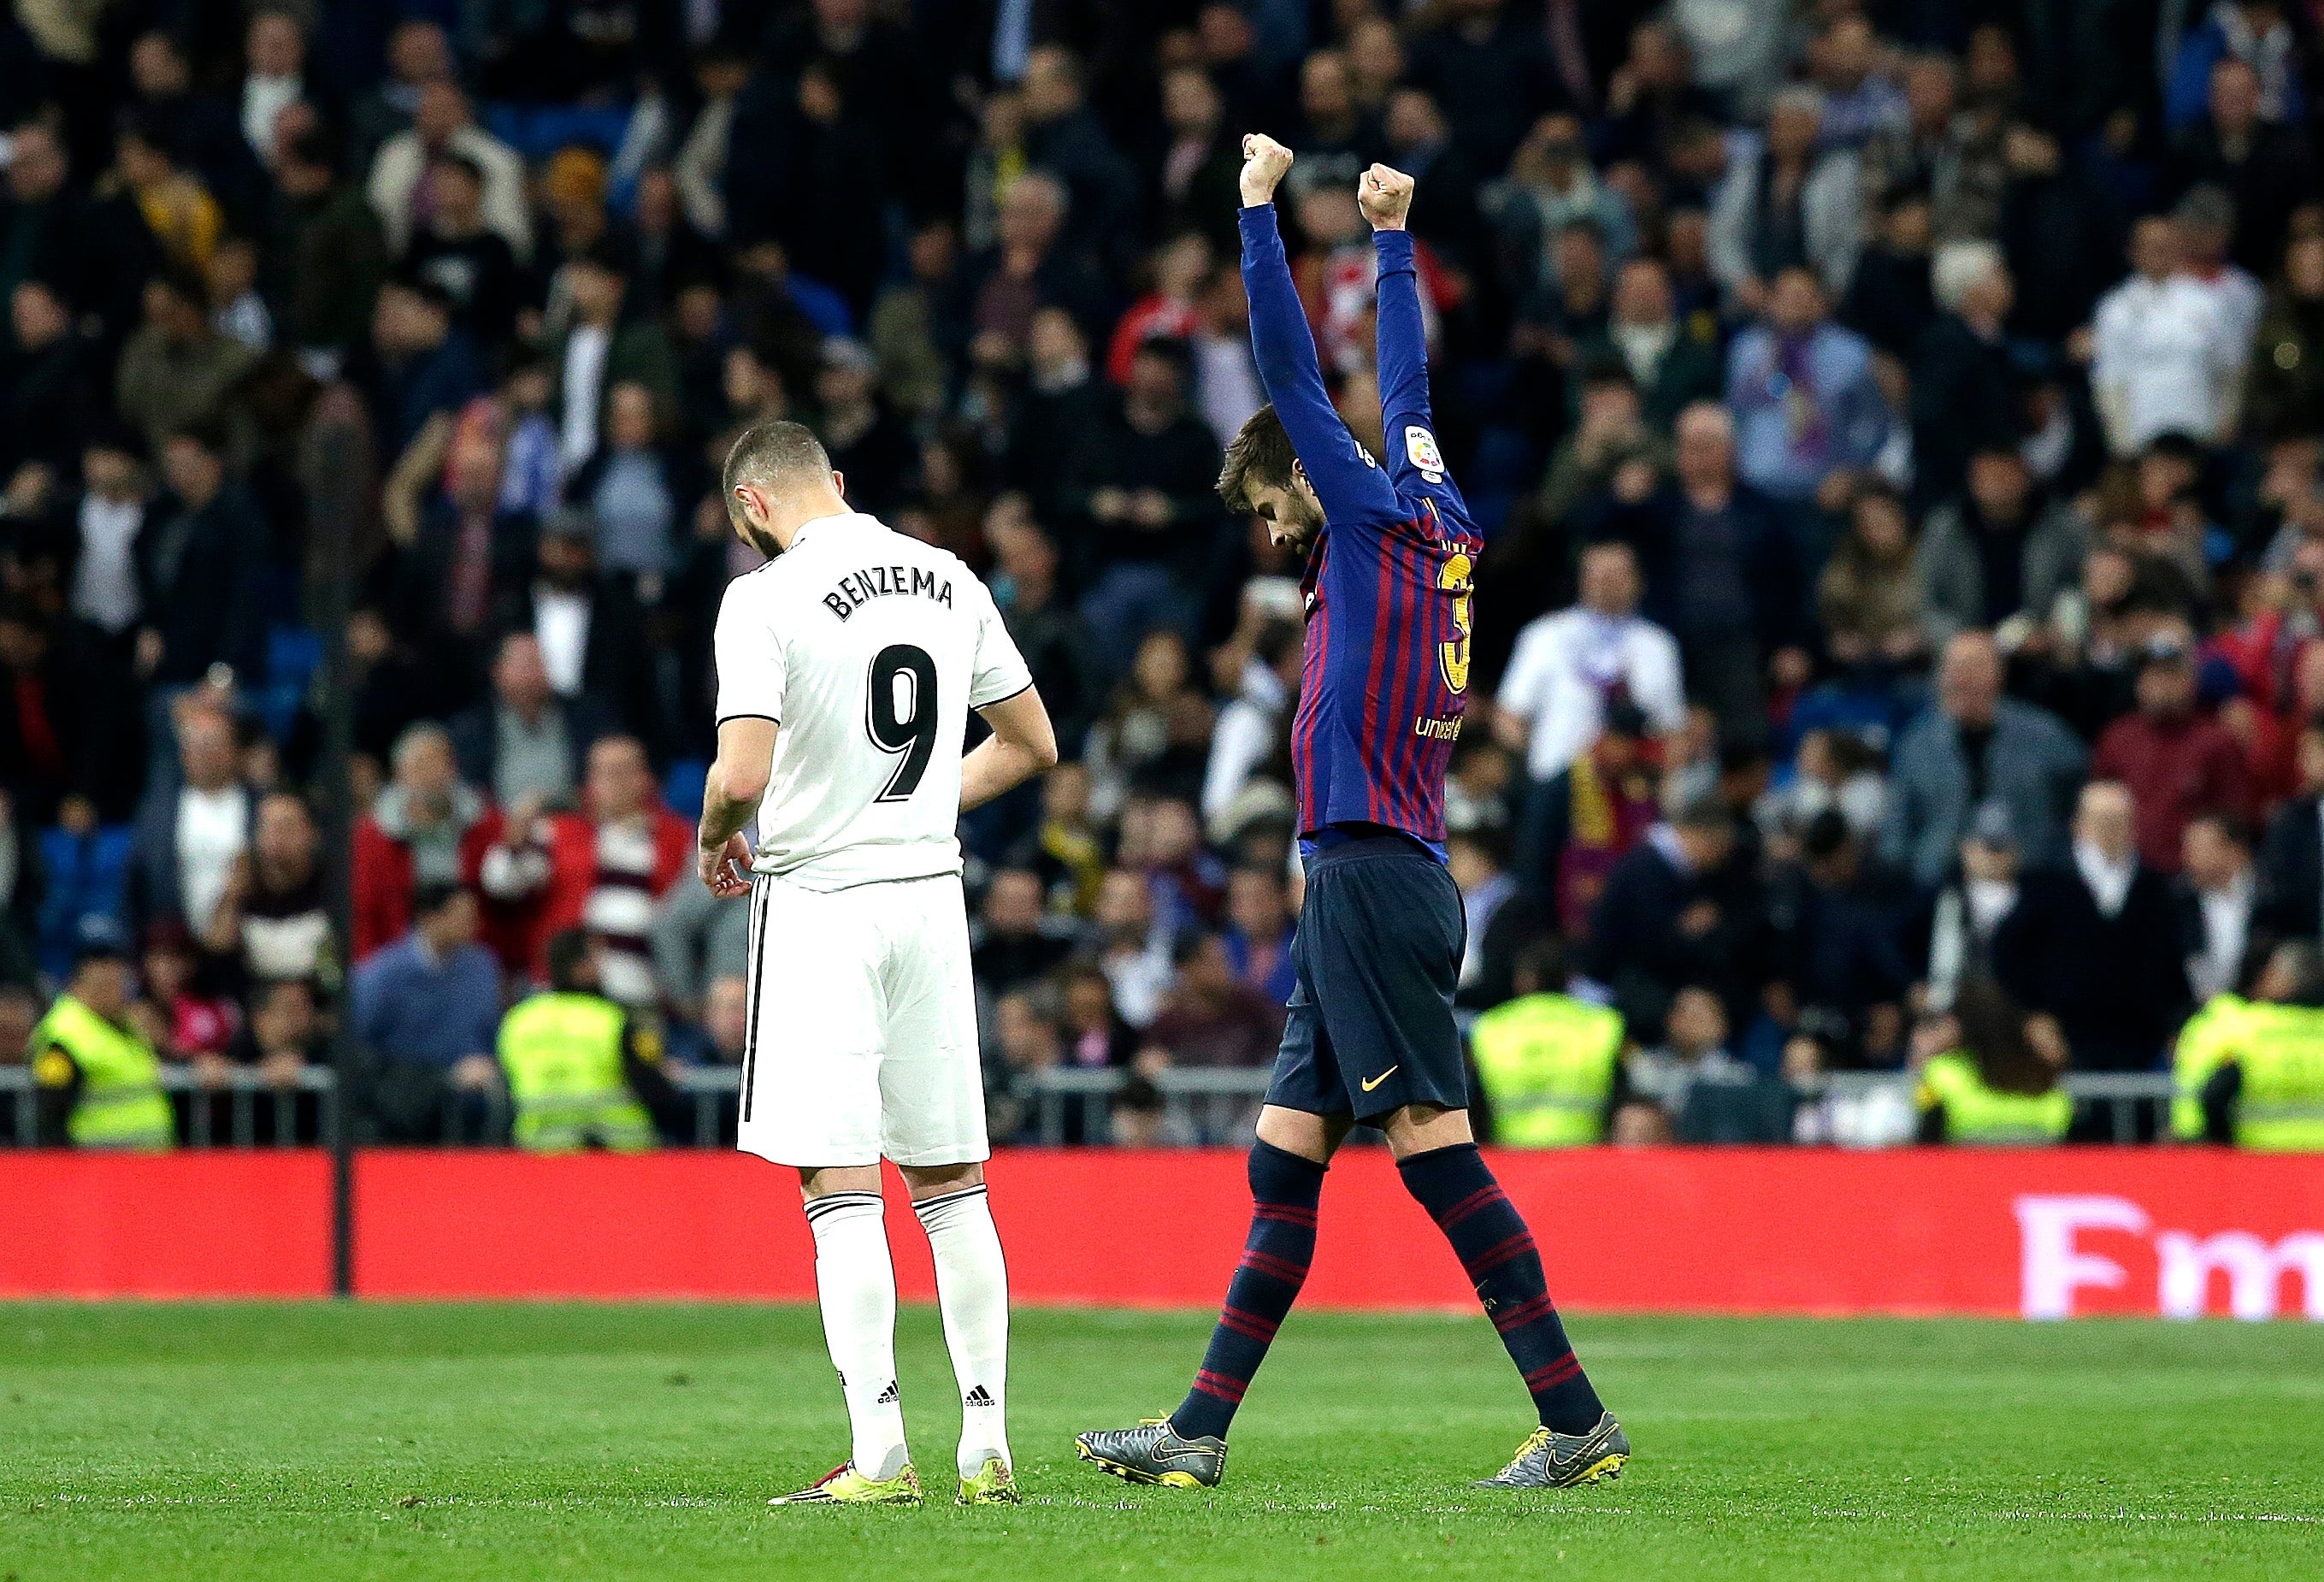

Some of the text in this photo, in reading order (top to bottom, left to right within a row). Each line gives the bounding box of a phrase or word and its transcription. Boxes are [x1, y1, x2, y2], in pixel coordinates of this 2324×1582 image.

[823, 566, 952, 623] BENZEMA
[1437, 553, 1474, 694] 3
[865, 644, 938, 803] 9
